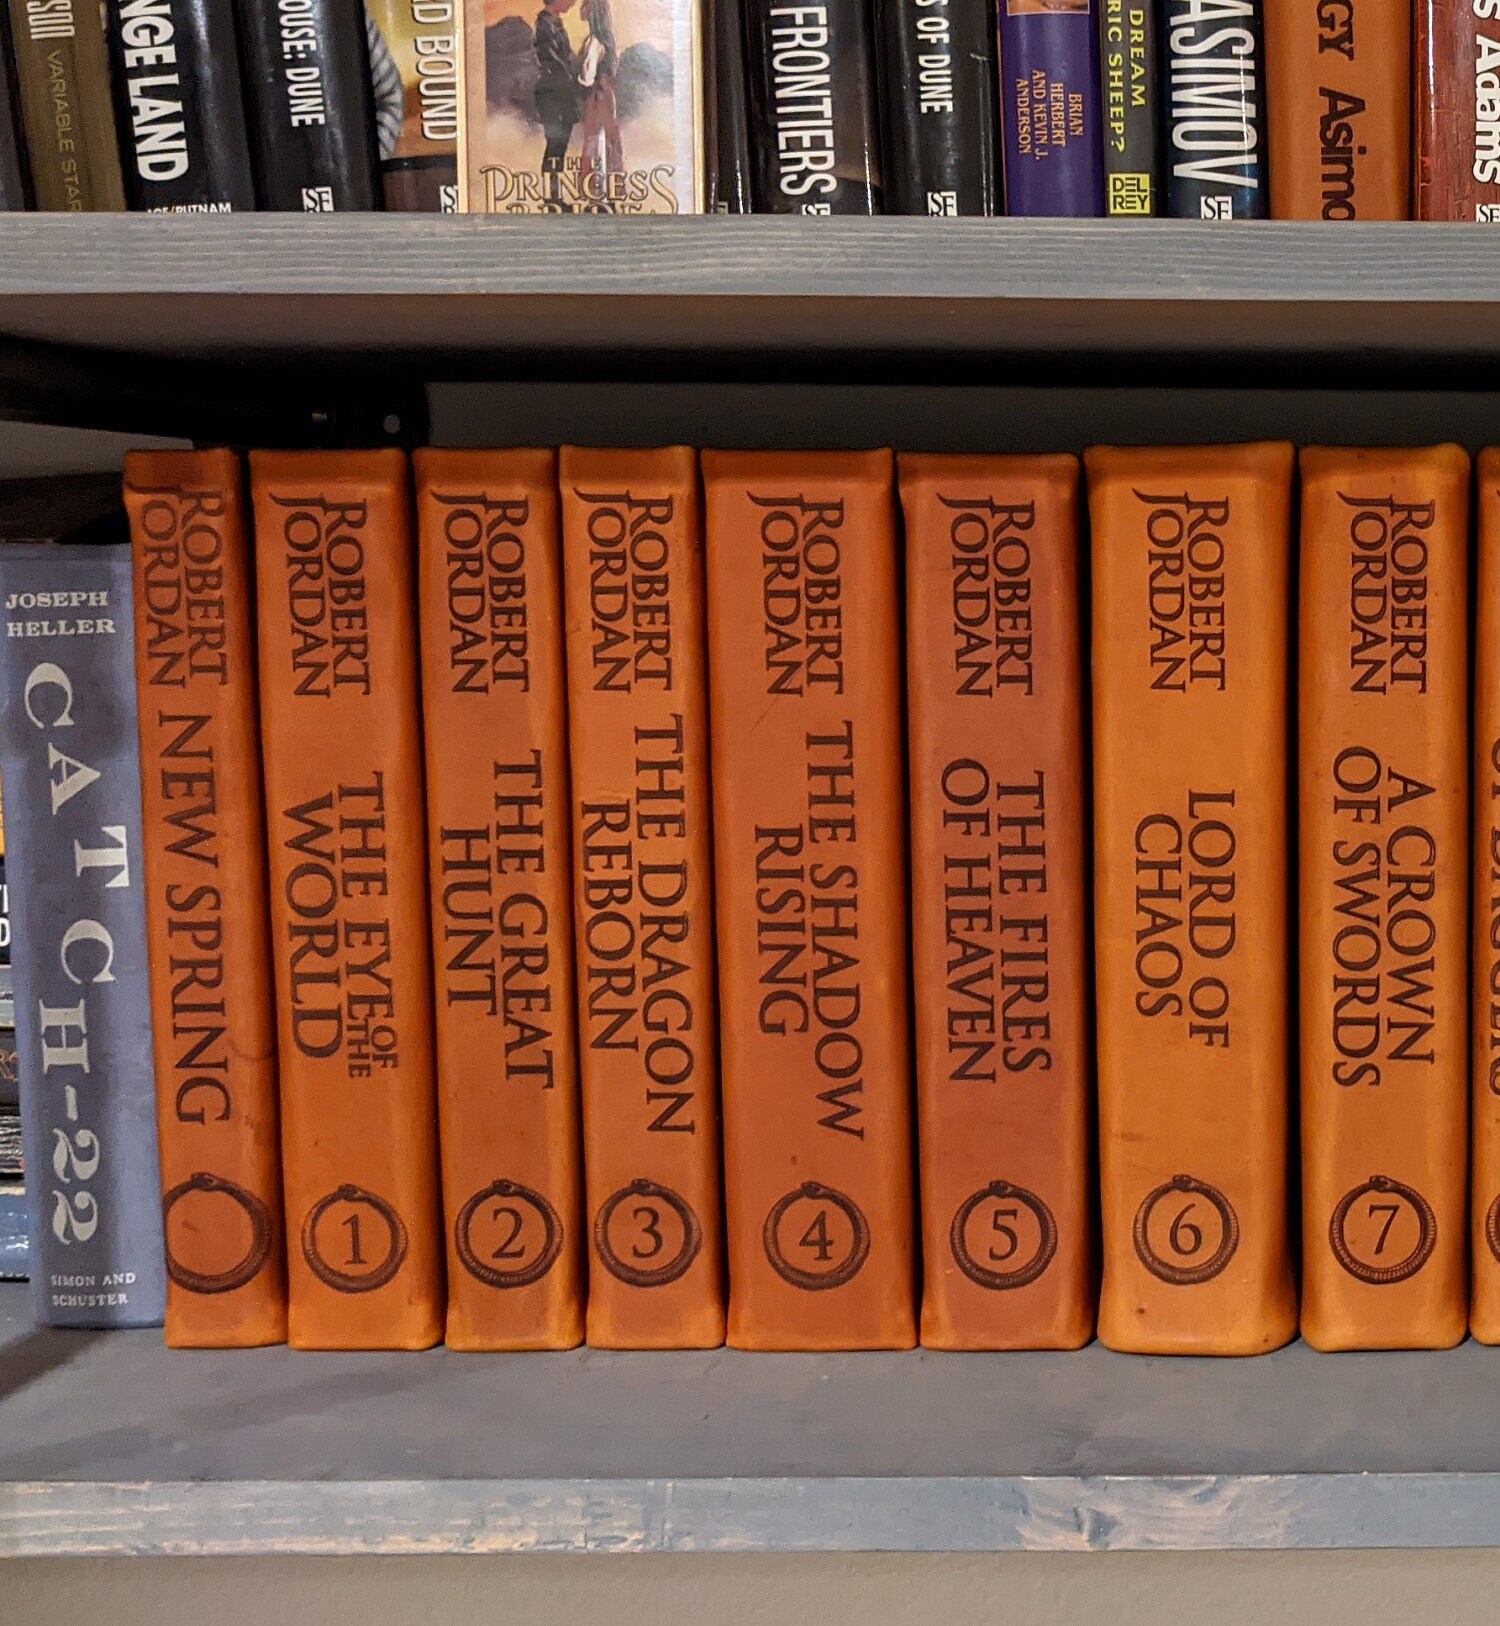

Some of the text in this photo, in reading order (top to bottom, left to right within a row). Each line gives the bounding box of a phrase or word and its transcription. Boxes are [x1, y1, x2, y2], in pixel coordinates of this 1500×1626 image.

[46, 50, 82, 212] VARIABLE STAR
[118, 0, 190, 181] NGE LAND
[277, 0, 326, 127] OUSE: DUNE
[414, 36, 459, 140] BOUND
[769, 6, 837, 195] FRONTIERS
[916, 17, 954, 114] OF DUNE
[1016, 78, 1032, 154] ANDERSON
[1032, 69, 1048, 160] AND KEVIN J.
[1050, 82, 1066, 147] HERBERT
[1068, 93, 1084, 136] BRIAN
[1107, 0, 1124, 152] RIC SHEEP?
[1129, 9, 1146, 107] DREAM
[1169, 0, 1258, 188] ASIMOV
[1316, 0, 1367, 220] GY Asimo
[480, 164, 679, 213] PRINCESS
[546, 156, 603, 172] THE
[1112, 177, 1148, 193] DEL
[1113, 195, 1148, 210] REY
[6, 591, 109, 610] JOSEPH
[6, 618, 116, 638] HELLER
[128, 481, 186, 689] JORDAN
[179, 484, 229, 686] ROBERT
[268, 492, 331, 698] JORDAN
[324, 495, 370, 697] ROBERT
[429, 488, 489, 694] JORDAN
[483, 492, 530, 693] ROBERT
[573, 487, 632, 694] JORDAN
[626, 490, 674, 691] ROBERT
[746, 491, 804, 697] JORDAN
[799, 494, 845, 695] ROBERT
[936, 493, 994, 698] JORDAN
[990, 495, 1036, 696] ROBERT
[1131, 487, 1187, 693] JORDAN
[1183, 491, 1230, 692] ROBERT
[1336, 490, 1396, 695] JORDAN
[1389, 493, 1435, 694] ROBERT
[158, 710, 231, 1126] NEW SPRING
[283, 791, 343, 1059] WORLD
[337, 770, 394, 1019] THE EYE
[440, 825, 498, 1016] HUNT
[493, 749, 554, 1090] THE GREAT
[581, 800, 639, 1052] REBORN
[634, 714, 696, 1135] THE DRAGON
[753, 822, 810, 1037] RISING
[805, 720, 865, 1140] THE SHADOW
[941, 757, 997, 1084] OF HEAVEN
[996, 770, 1052, 1073] THE FIRES
[1134, 813, 1184, 1019] CHAOS
[1186, 789, 1237, 1049] LORD OF
[1332, 746, 1382, 1088] OF SWORDS
[1386, 767, 1436, 1065] A CROWN
[347, 1019, 372, 1079] THE
[367, 1023, 398, 1070] OF
[50, 1272, 136, 1287] SIMON AND
[52, 1293, 128, 1306] SCHUSTER
[343, 1213, 367, 1265] 1
[492, 1209, 525, 1260] 2
[630, 1208, 663, 1259] 3
[799, 1210, 834, 1261] 4
[988, 1209, 1018, 1261] 5
[1169, 1203, 1202, 1256] 6
[1367, 1204, 1400, 1255] 7
